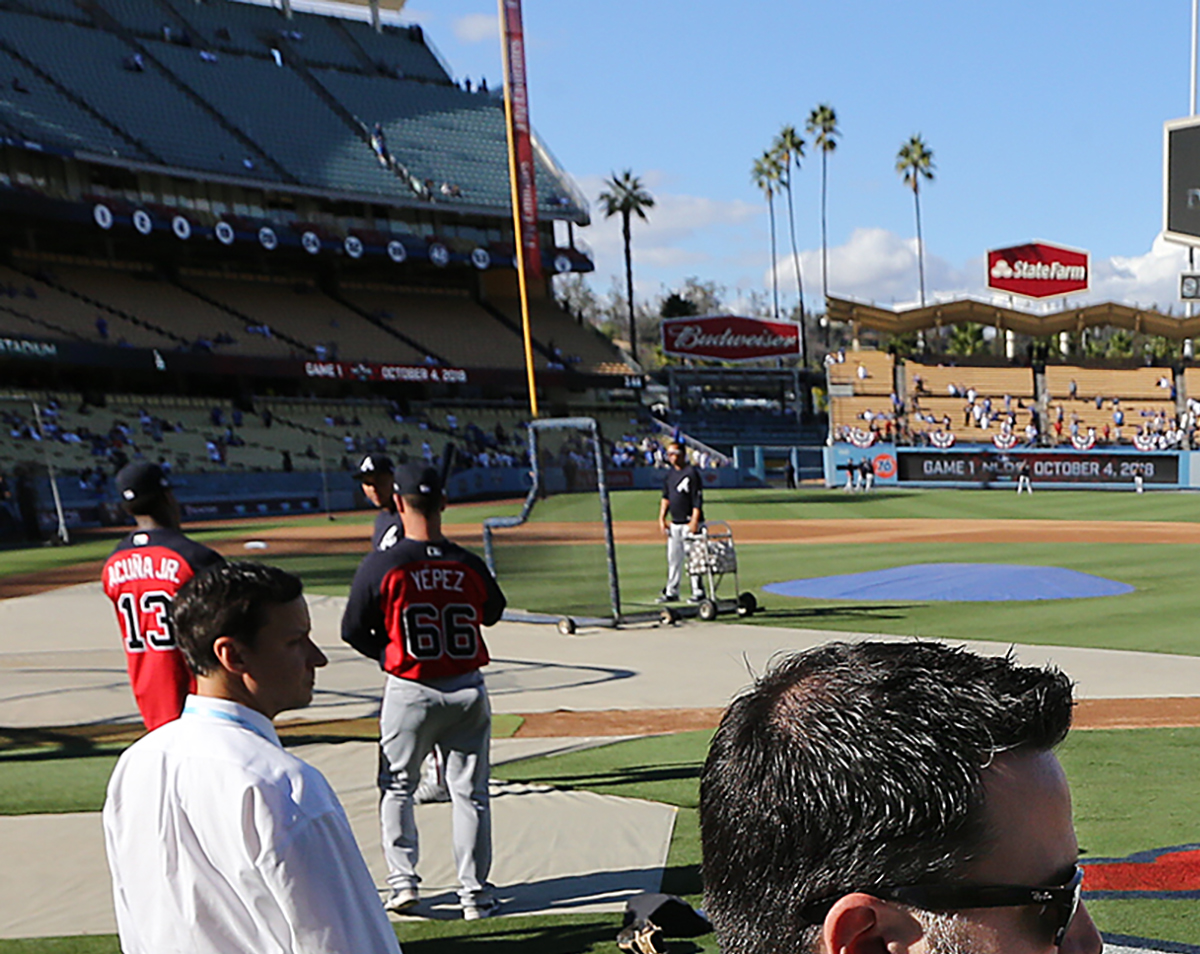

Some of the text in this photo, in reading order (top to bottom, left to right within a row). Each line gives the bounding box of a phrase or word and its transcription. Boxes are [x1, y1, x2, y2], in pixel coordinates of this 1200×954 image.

[668, 323, 797, 349] Budweiser
[381, 366, 428, 379] OCTOBER
[878, 459, 893, 473] 76
[923, 460, 974, 475] GAME 1
[1033, 461, 1154, 477] OCTOBER 4, 208
[108, 553, 180, 587] ACUÑA JR.
[118, 590, 177, 653] 13
[403, 603, 478, 660] 66
